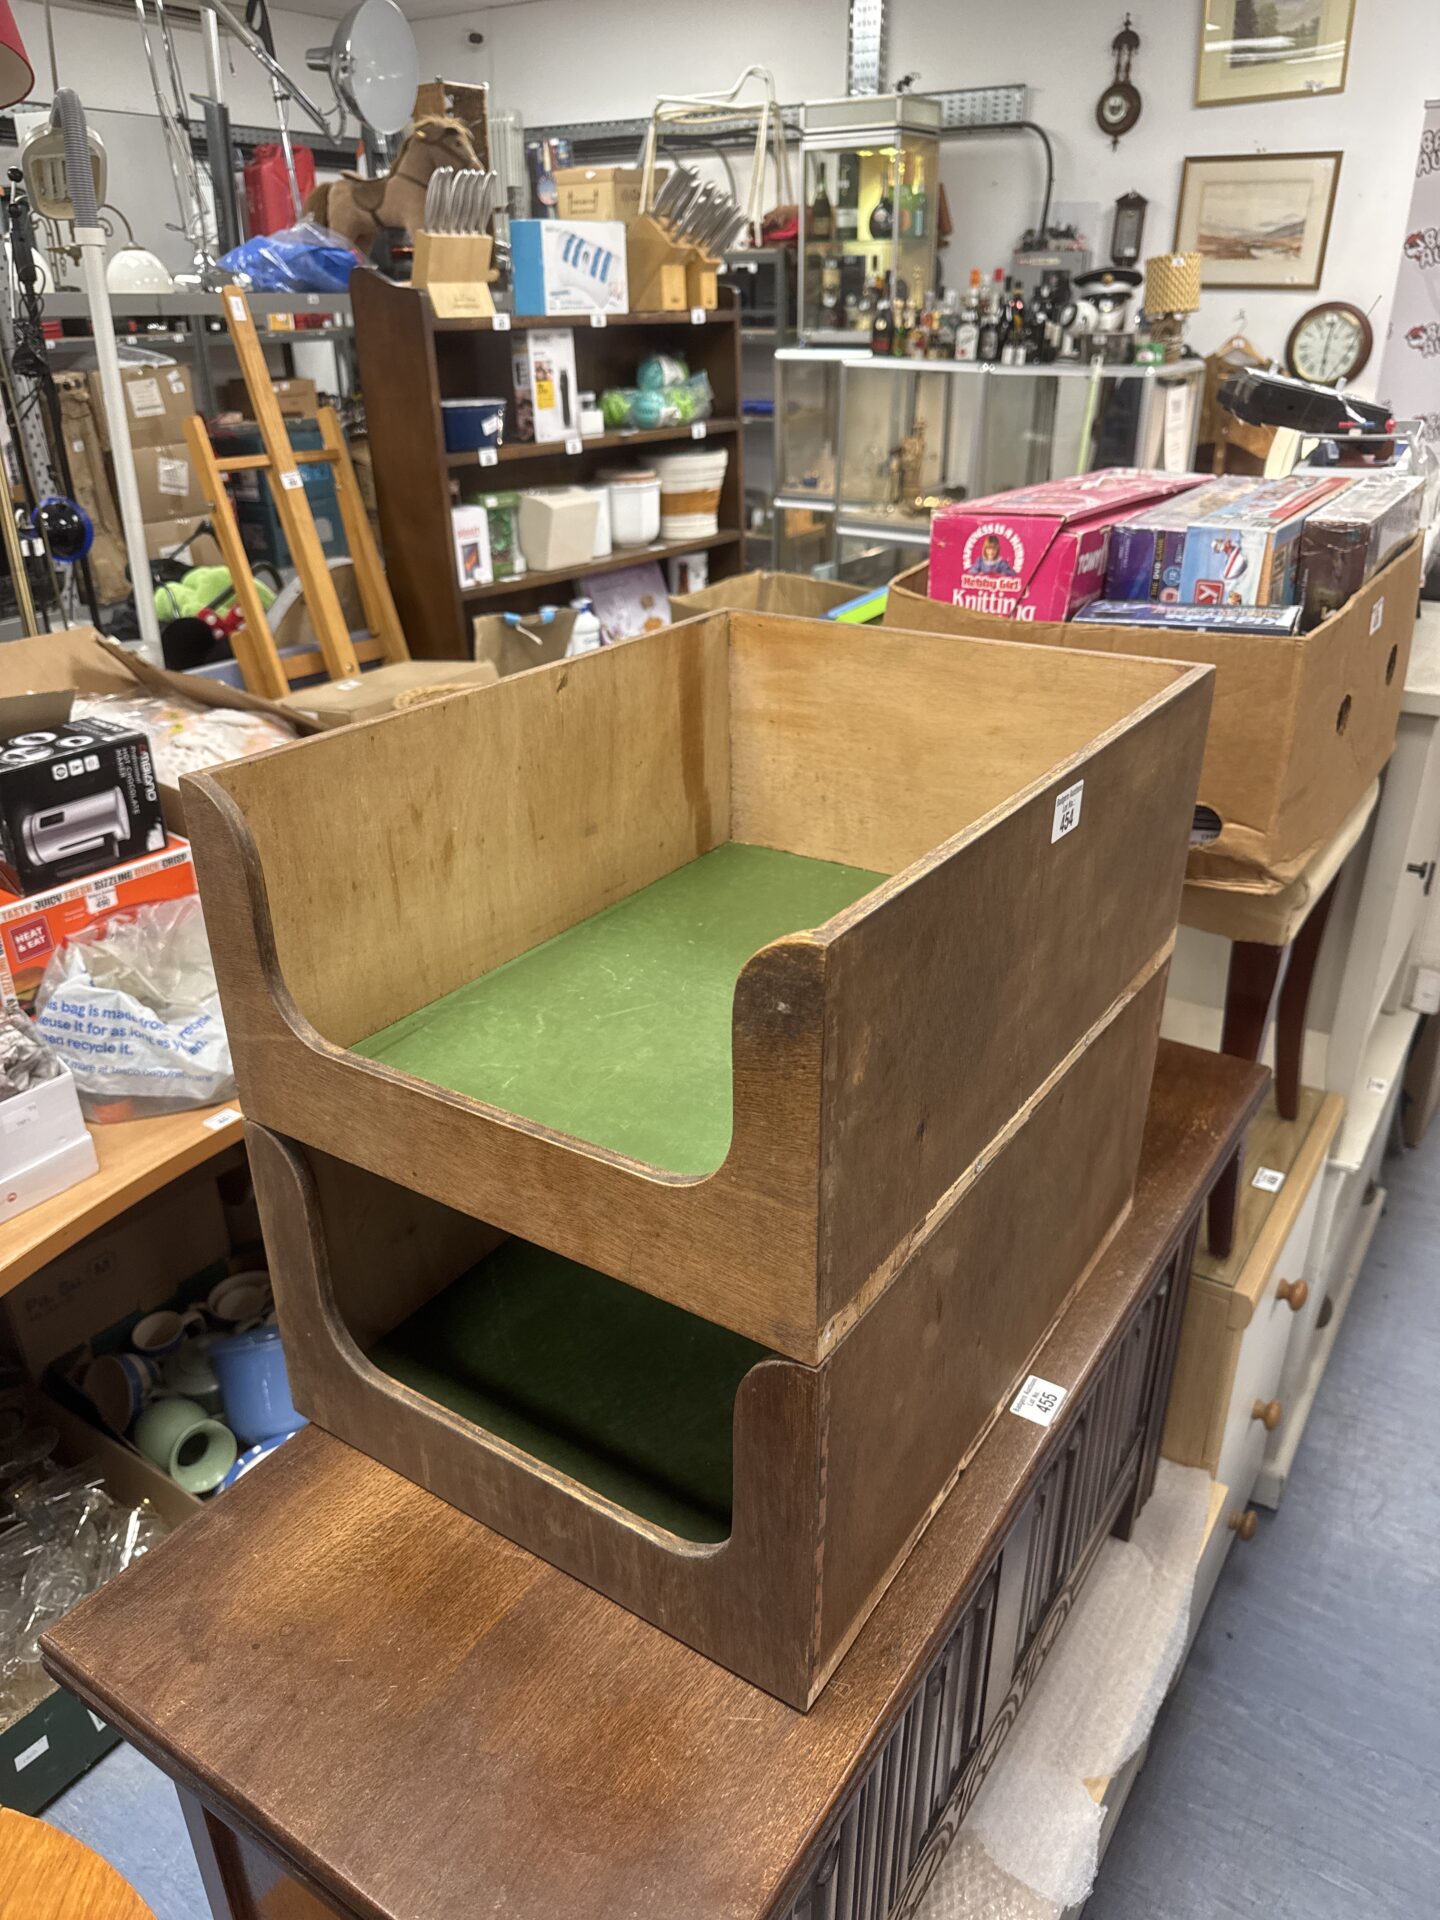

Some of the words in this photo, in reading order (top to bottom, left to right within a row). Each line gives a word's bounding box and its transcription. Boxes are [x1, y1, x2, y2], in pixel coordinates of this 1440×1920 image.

[115, 749, 126, 779] MAKER
[126, 766, 141, 815] CHOCOLATE
[1060, 808, 1074, 832] 454
[34, 894, 63, 910] JUICY
[94, 871, 133, 889] SIZZLING
[15, 926, 44, 943] HEAT
[18, 943, 27, 953] &
[28, 936, 47, 950] EAT
[61, 999, 86, 1019] bag
[88, 1003, 99, 1017] is
[74, 1020, 84, 1033] it
[87, 1022, 108, 1037] for
[111, 1027, 126, 1038] as
[67, 1036, 117, 1055] recycle
[119, 1042, 134, 1055] it.
[1036, 1392, 1058, 1413] 455
